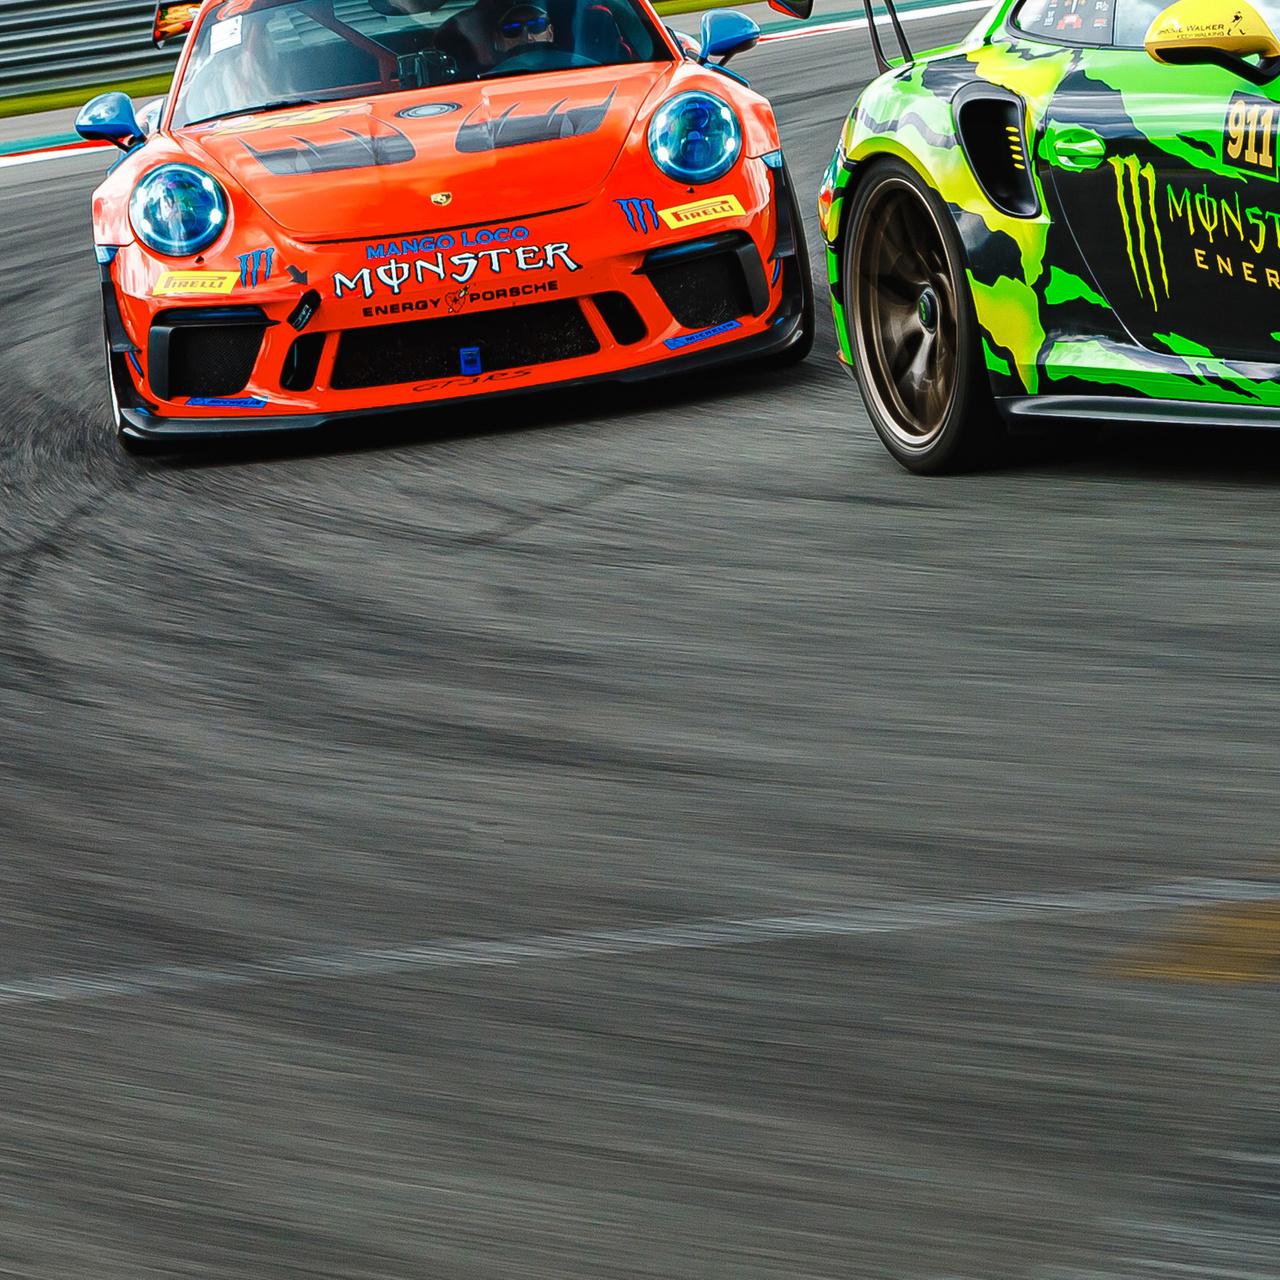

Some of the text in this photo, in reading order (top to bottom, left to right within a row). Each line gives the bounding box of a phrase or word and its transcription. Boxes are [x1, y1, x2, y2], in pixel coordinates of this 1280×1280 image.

[1187, 23, 1225, 32] WALKER
[1227, 99, 1274, 168] 911
[671, 200, 734, 223] PIRELLI
[366, 226, 529, 260] MANGO LOCO
[164, 276, 227, 289] PIRELLI
[362, 280, 559, 318] ENERGY PORSCHE
[685, 322, 734, 342] MICHELIN
